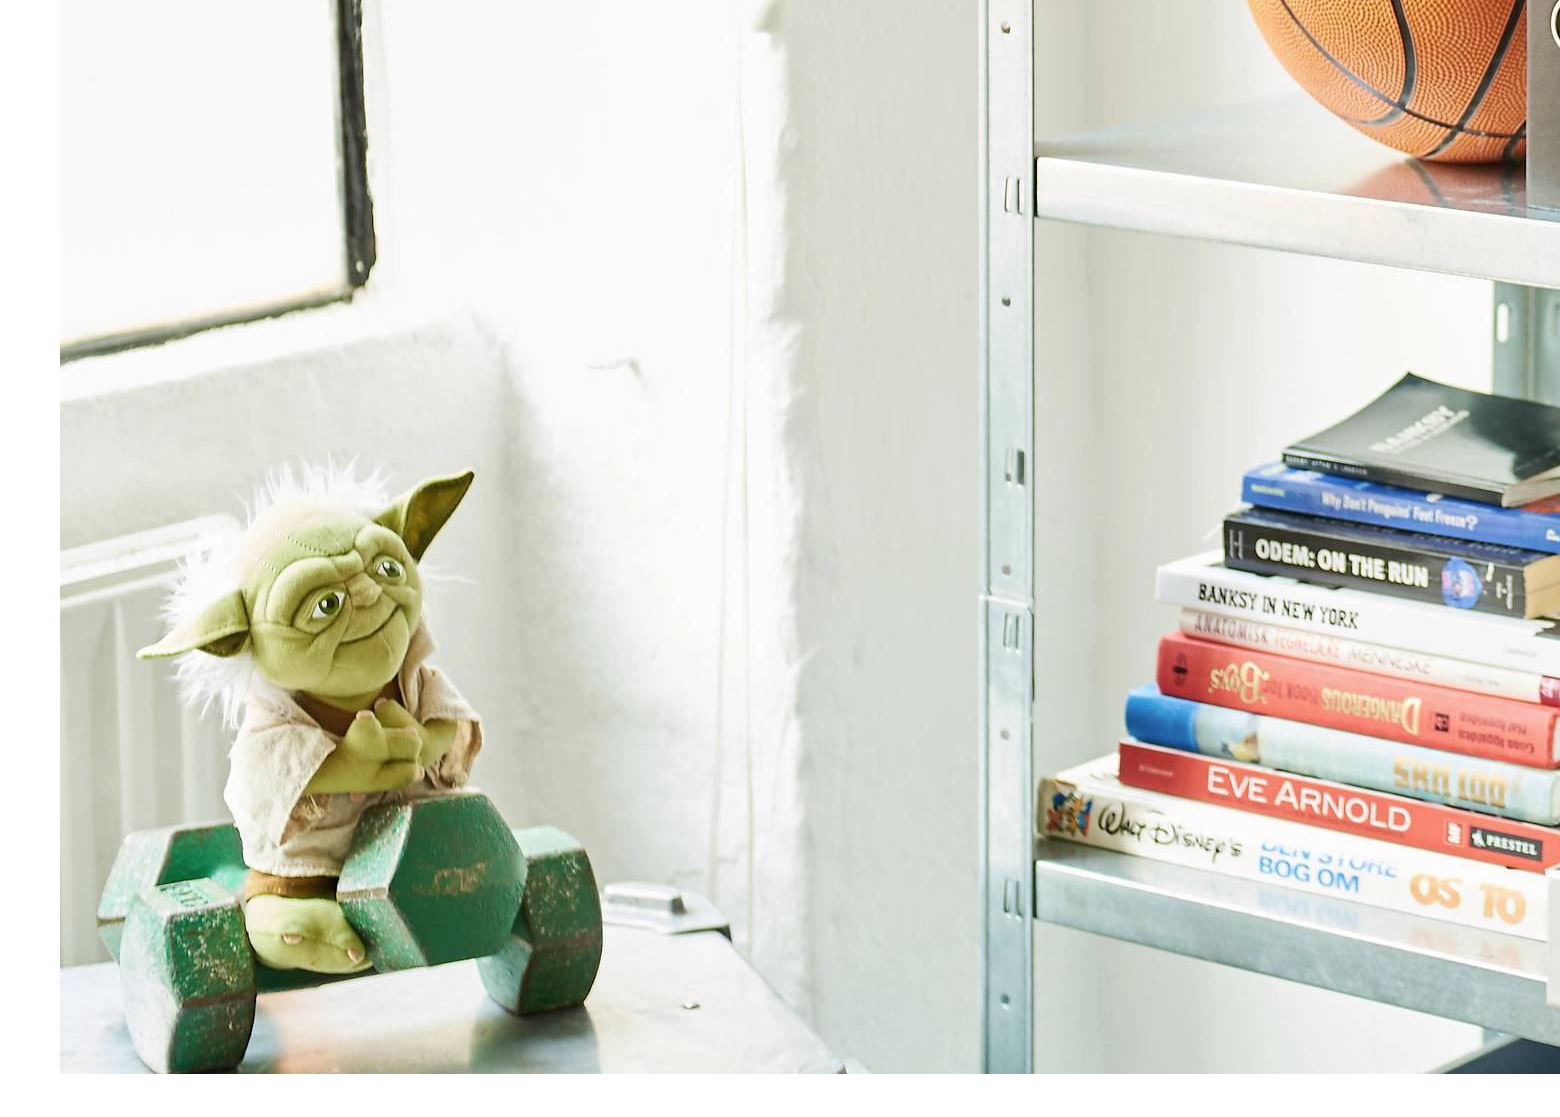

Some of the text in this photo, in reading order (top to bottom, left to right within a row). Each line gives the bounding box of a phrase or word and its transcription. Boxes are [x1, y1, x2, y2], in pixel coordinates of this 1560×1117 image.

[1254, 536, 1316, 569] ODEM:
[1317, 548, 1347, 573] ON
[1348, 553, 1386, 581] THE
[1387, 560, 1430, 589] RUN
[1197, 582, 1360, 630] BANKSY IN NEW YORK
[1206, 765, 1268, 804] EVE
[1274, 780, 1412, 833] ARNOLD
[1485, 833, 1538, 856] PRESTEL
[1259, 855, 1360, 894] BOG OM
[1408, 872, 1527, 926] OS TO
